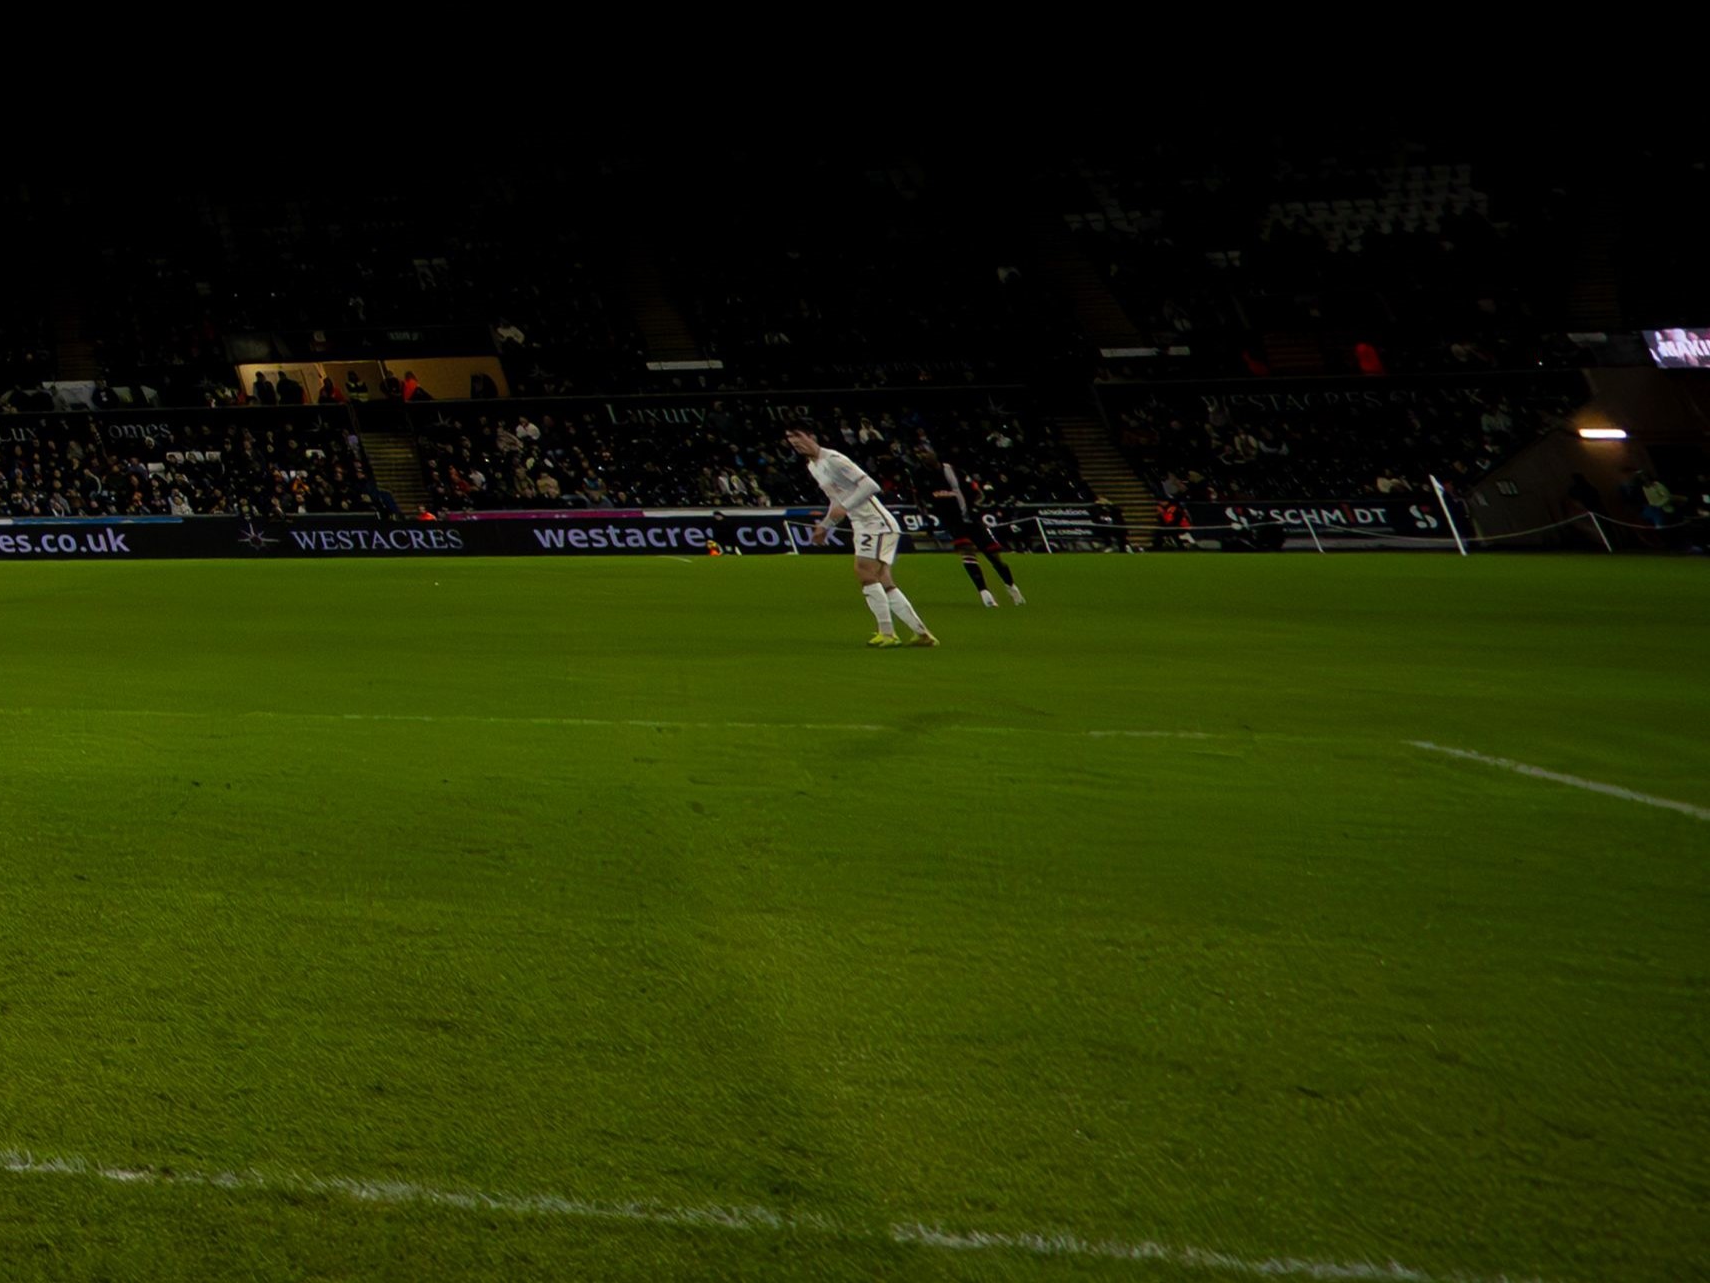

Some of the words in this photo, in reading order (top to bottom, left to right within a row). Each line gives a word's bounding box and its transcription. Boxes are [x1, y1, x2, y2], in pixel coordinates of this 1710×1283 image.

[108, 421, 172, 441] omes
[1268, 503, 1389, 526] SCHMIDT
[291, 528, 464, 551] WESTACRES
[533, 519, 845, 549] westacreco.uk
